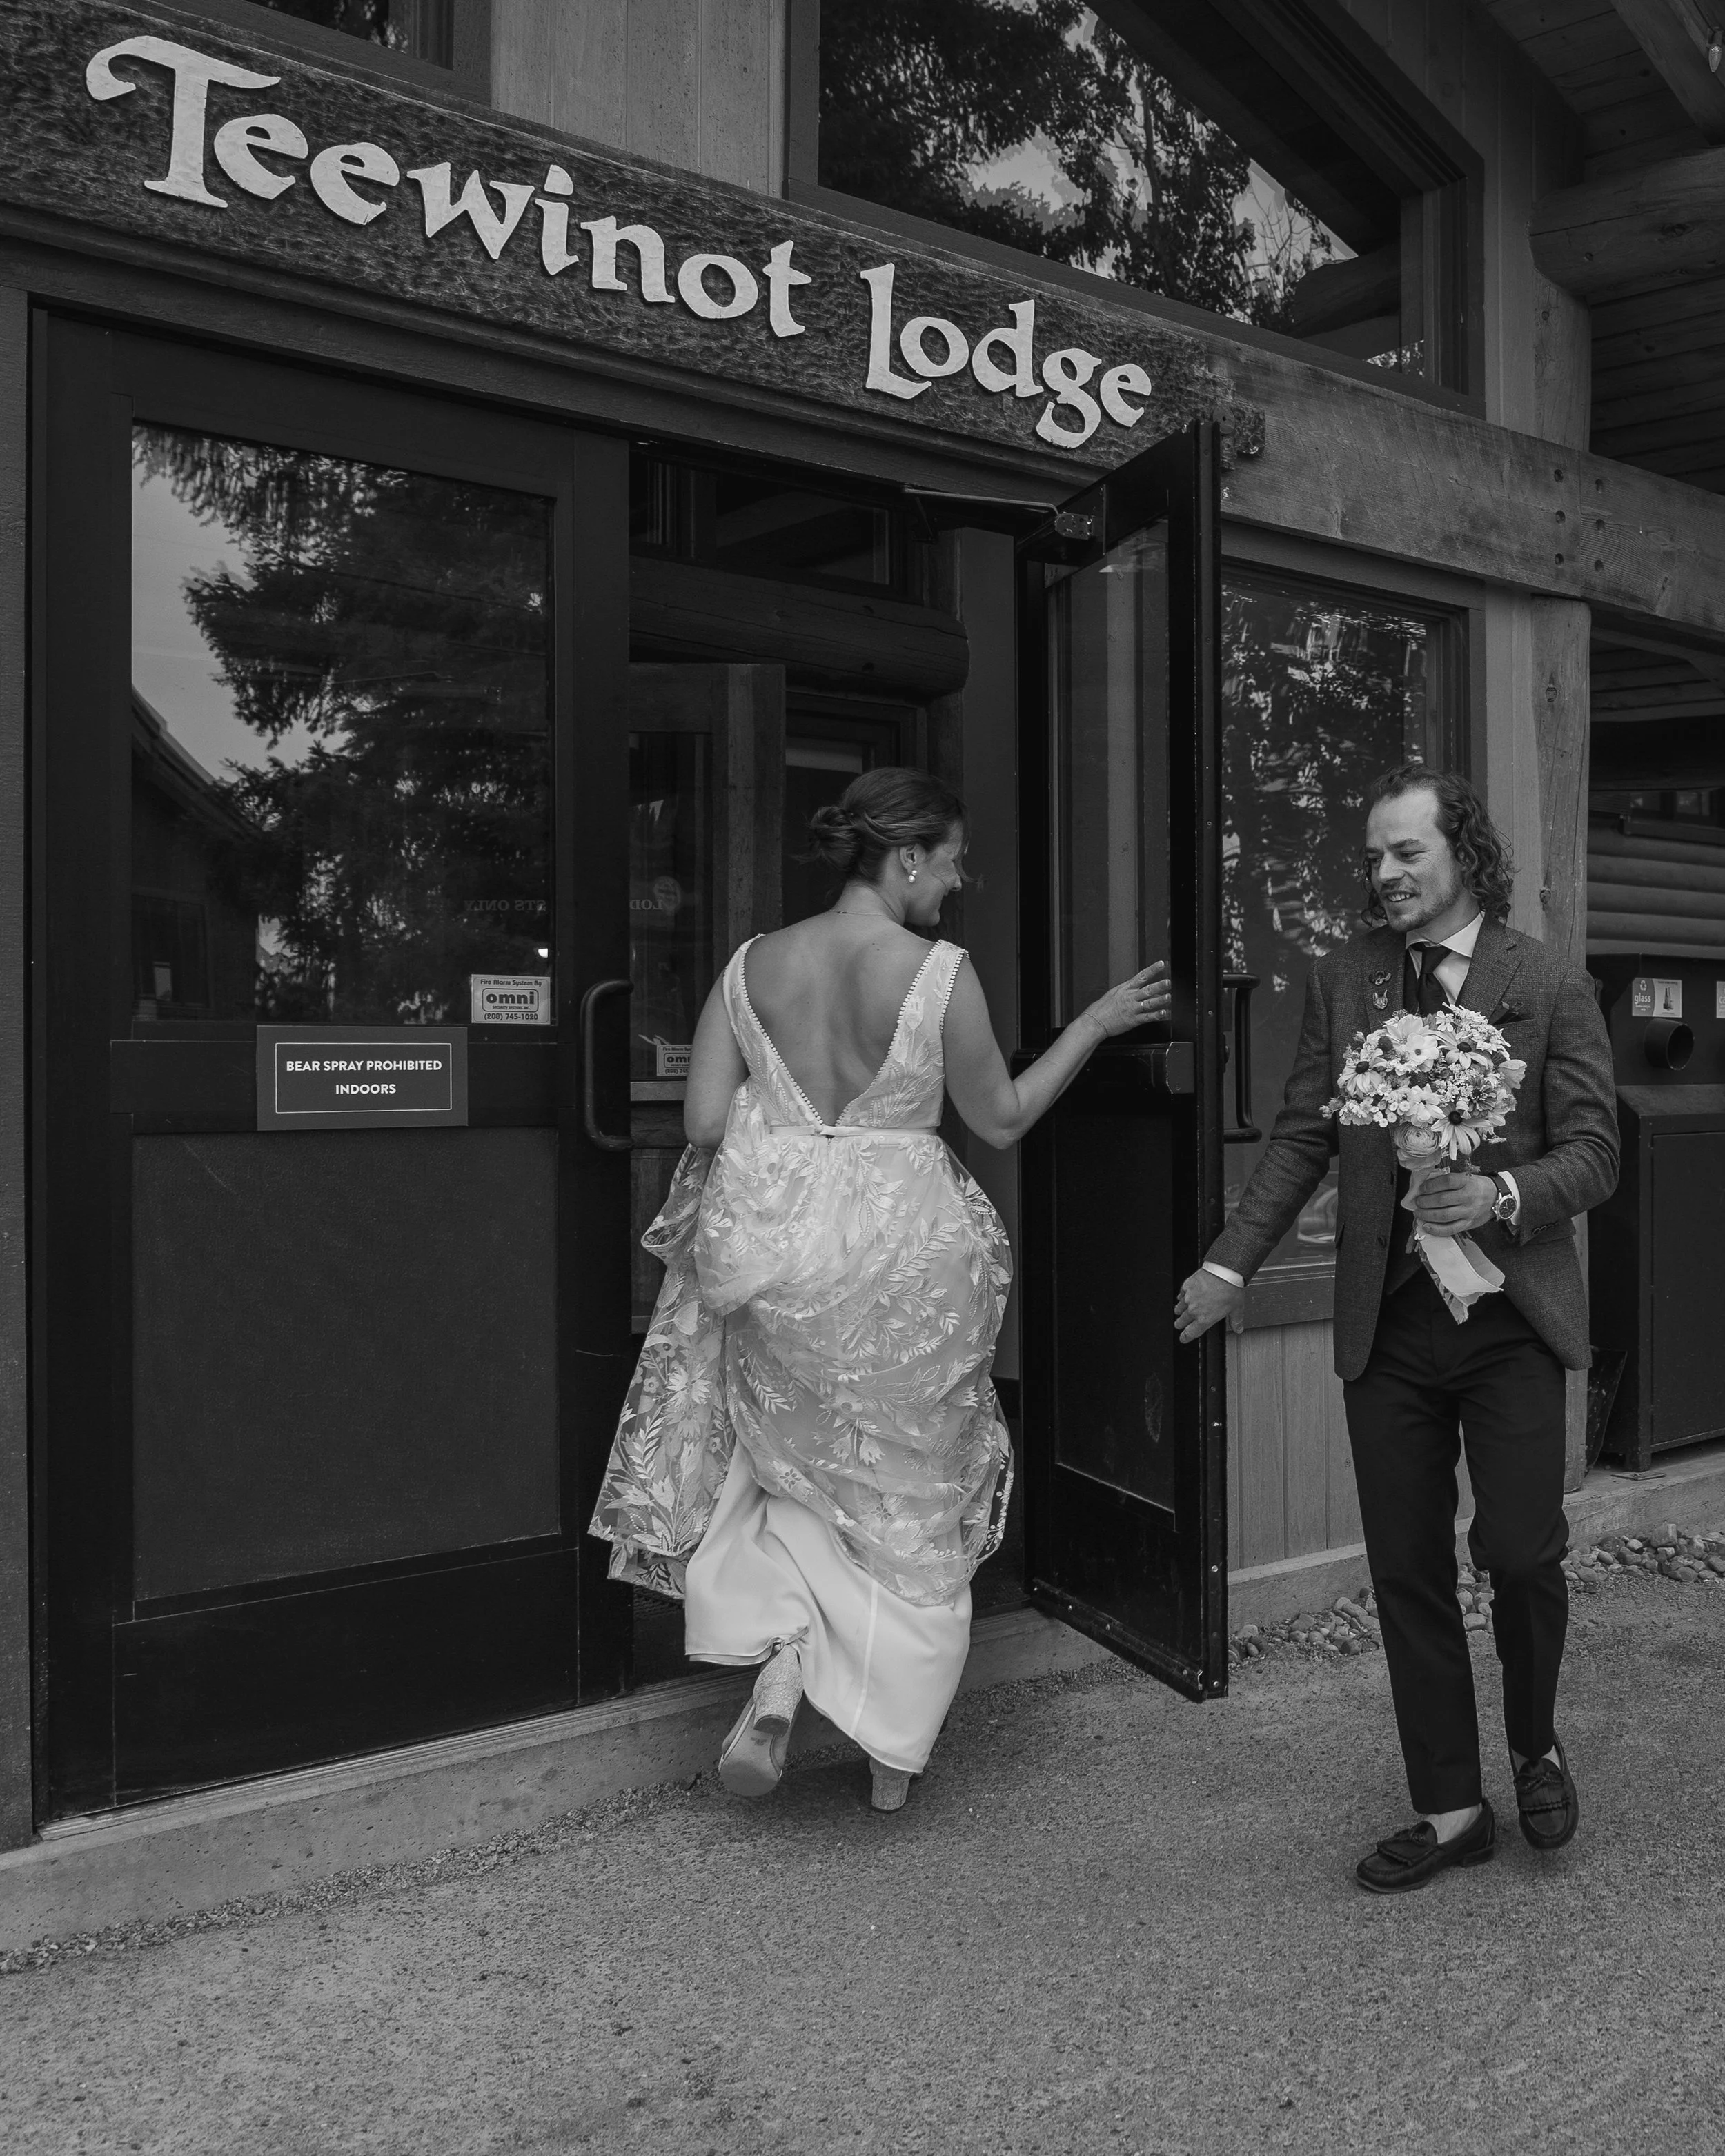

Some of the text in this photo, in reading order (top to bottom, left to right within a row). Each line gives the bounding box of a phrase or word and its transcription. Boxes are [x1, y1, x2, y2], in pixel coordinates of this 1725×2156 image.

[85, 34, 1152, 450] Teewinot Lodge
[486, 991, 534, 1005] omni
[1635, 992, 1651, 1005] glass
[484, 1013, 503, 1021] (208)
[286, 1060, 442, 1071] BEAR SPRAY PROHIBITED
[335, 1084, 397, 1094] INDOORS
